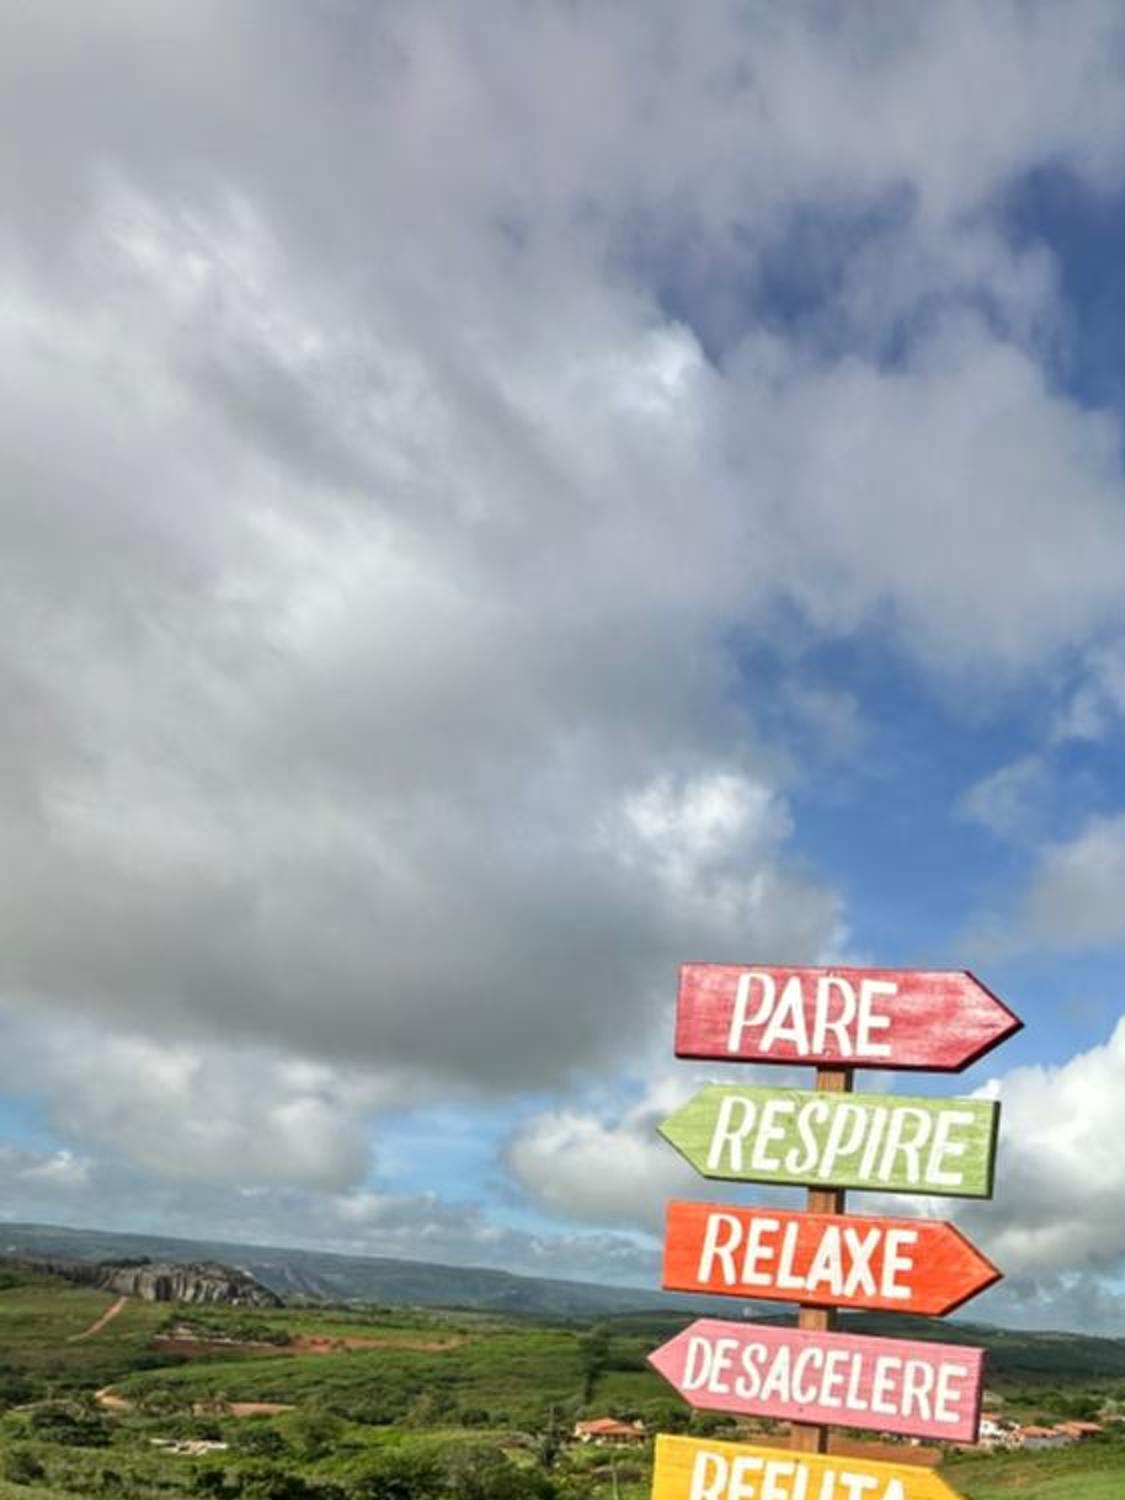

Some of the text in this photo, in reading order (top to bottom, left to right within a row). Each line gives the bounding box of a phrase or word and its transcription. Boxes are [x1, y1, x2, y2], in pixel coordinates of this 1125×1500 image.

[728, 972, 898, 1057] PARE
[707, 1096, 975, 1185] RESPIRE
[698, 1213, 919, 1299] RELAXE
[682, 1337, 968, 1423] DESACELERE
